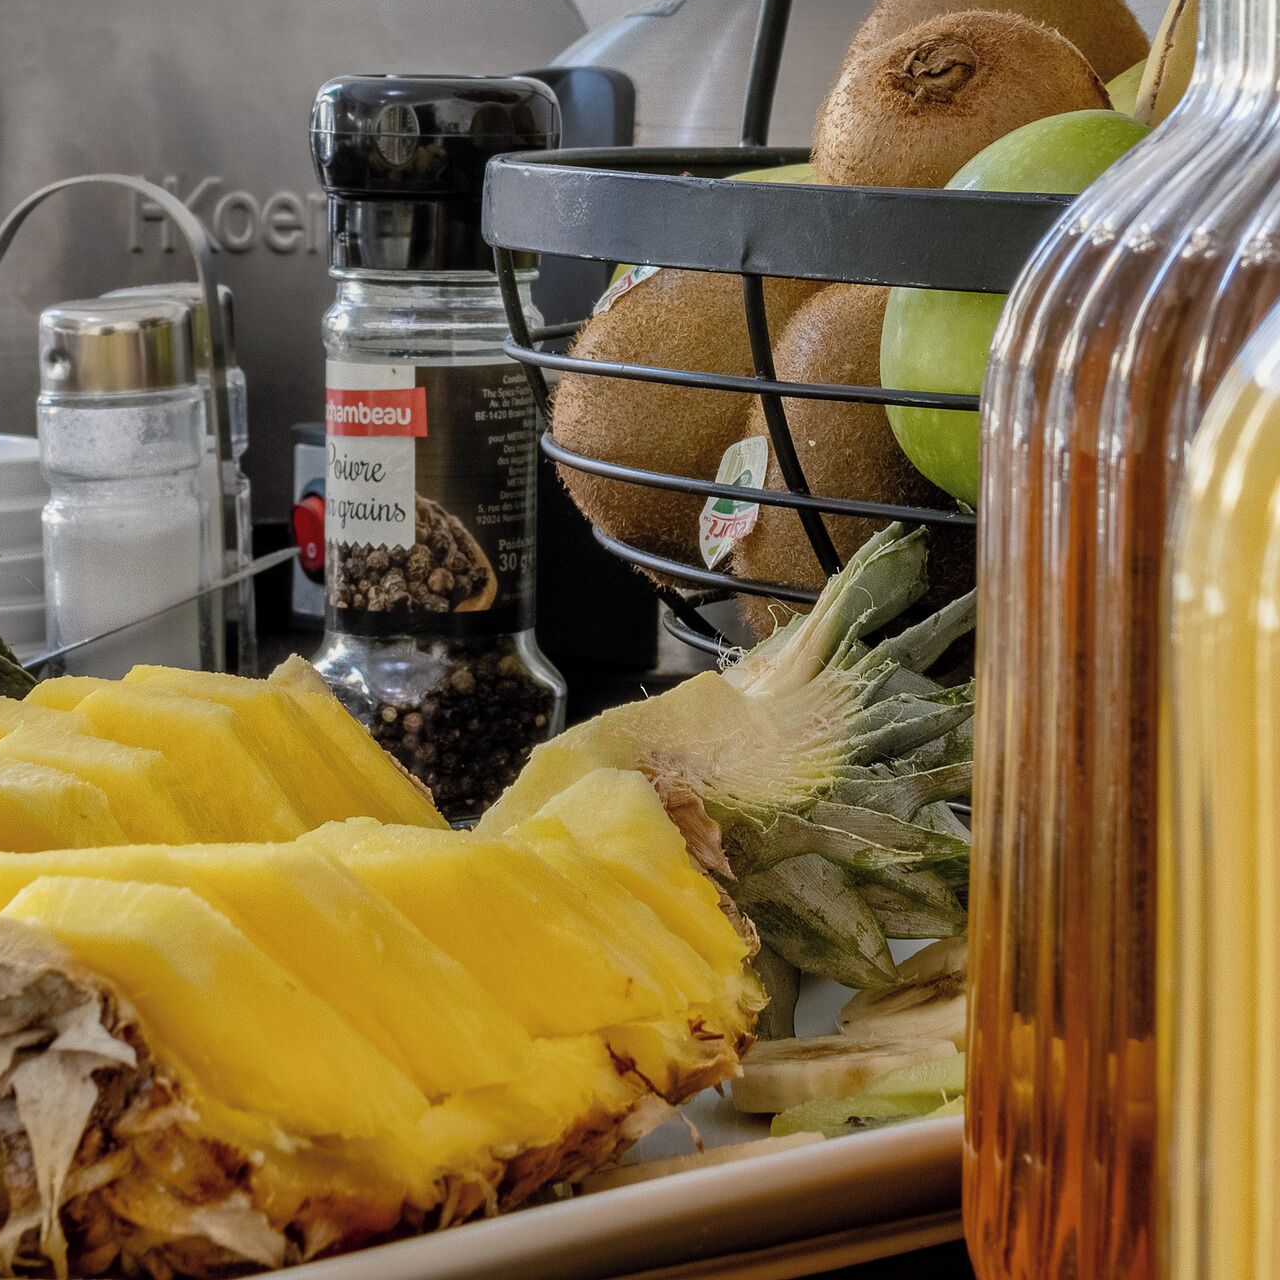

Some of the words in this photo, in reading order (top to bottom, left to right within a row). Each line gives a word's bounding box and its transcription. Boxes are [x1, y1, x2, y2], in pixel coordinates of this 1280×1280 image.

[338, 498, 406, 529] grains
[704, 516, 747, 541] espri
[499, 552, 517, 572] 30
